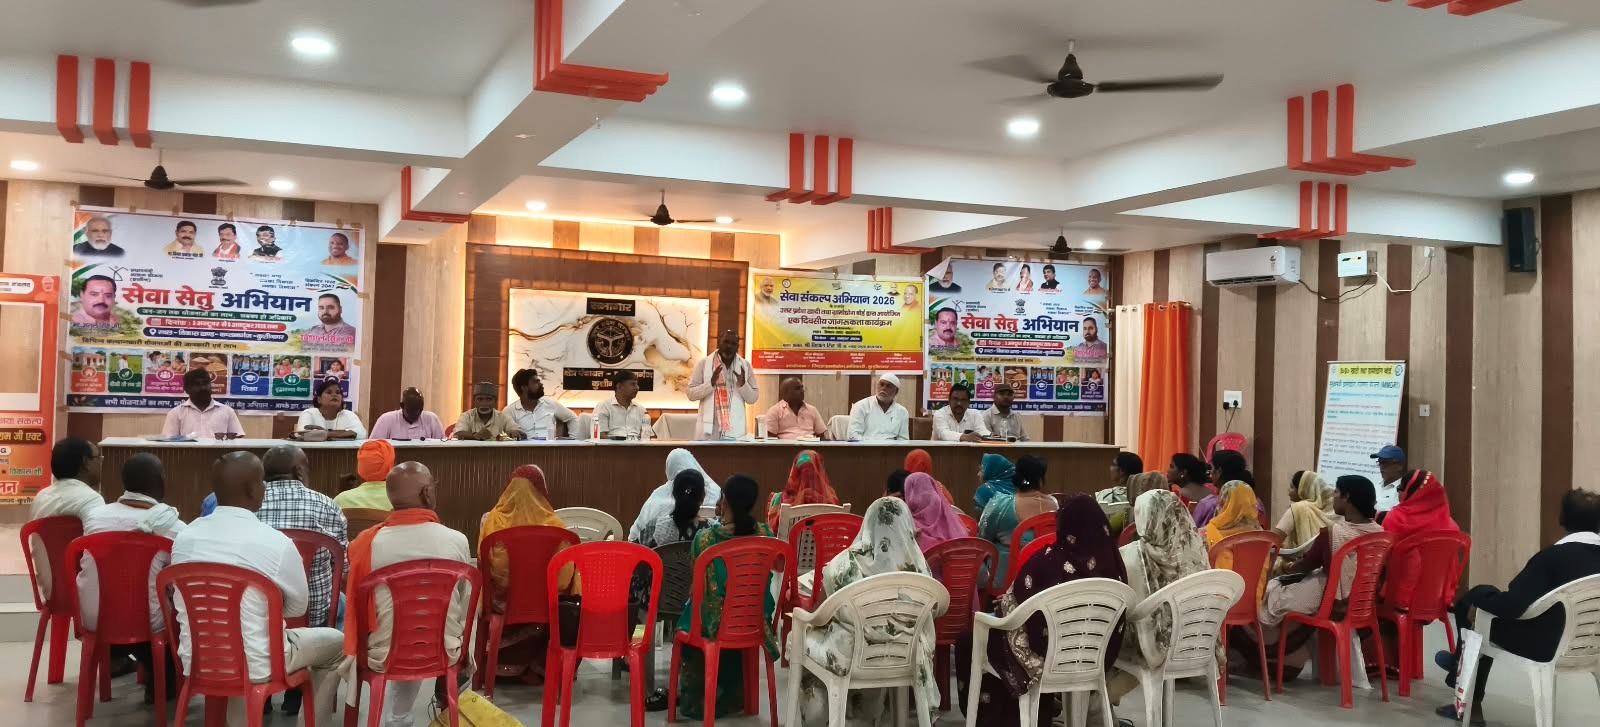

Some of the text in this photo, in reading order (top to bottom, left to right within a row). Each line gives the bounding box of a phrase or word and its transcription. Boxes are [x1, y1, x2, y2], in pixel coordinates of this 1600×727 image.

[122, 283, 312, 312] सेवा सेतु अभियान
[780, 290, 895, 305] सेवा संकल्प अभियान 2026
[793, 307, 806, 315] प्रदेश
[807, 306, 820, 315] खादी
[856, 309, 865, 317] बोर्ड
[788, 317, 800, 325] एक
[801, 315, 827, 325] दिवसीय
[865, 317, 893, 327] कार्यक्रम
[961, 313, 1080, 332] सेवा सेतु अभियान
[592, 378, 613, 390] कुशीन
[119, 398, 148, 406] योजनाओं
[14, 430, 42, 441] जी एक्ट
